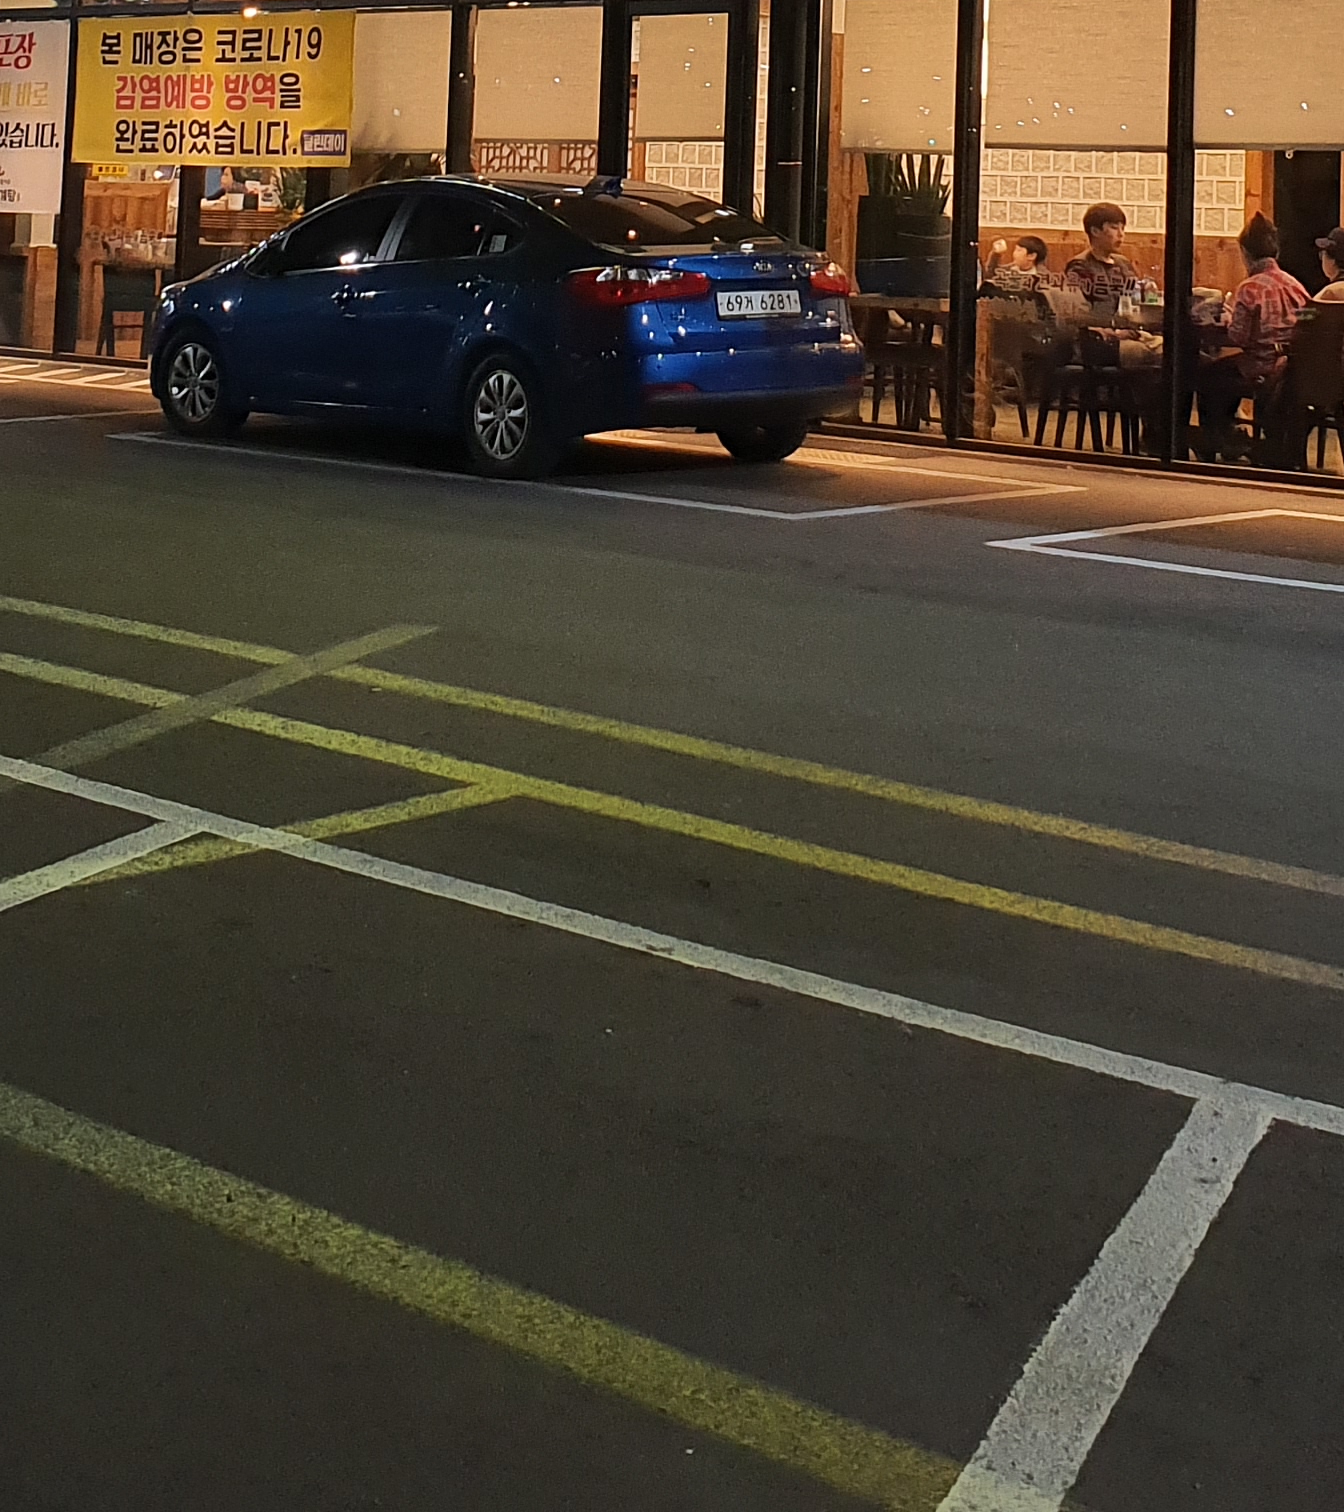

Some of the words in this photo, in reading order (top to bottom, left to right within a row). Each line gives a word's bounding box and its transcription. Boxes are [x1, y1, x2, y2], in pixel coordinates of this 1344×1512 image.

[101, 32, 121, 65] 본
[131, 28, 203, 65] 매장은
[214, 26, 322, 63] 코로나19
[16, 82, 48, 107] 바로
[115, 73, 214, 110] 감염예방
[224, 72, 301, 110] 방역을
[115, 119, 298, 155] 완료하였습니다.
[760, 293, 792, 310] 6281
